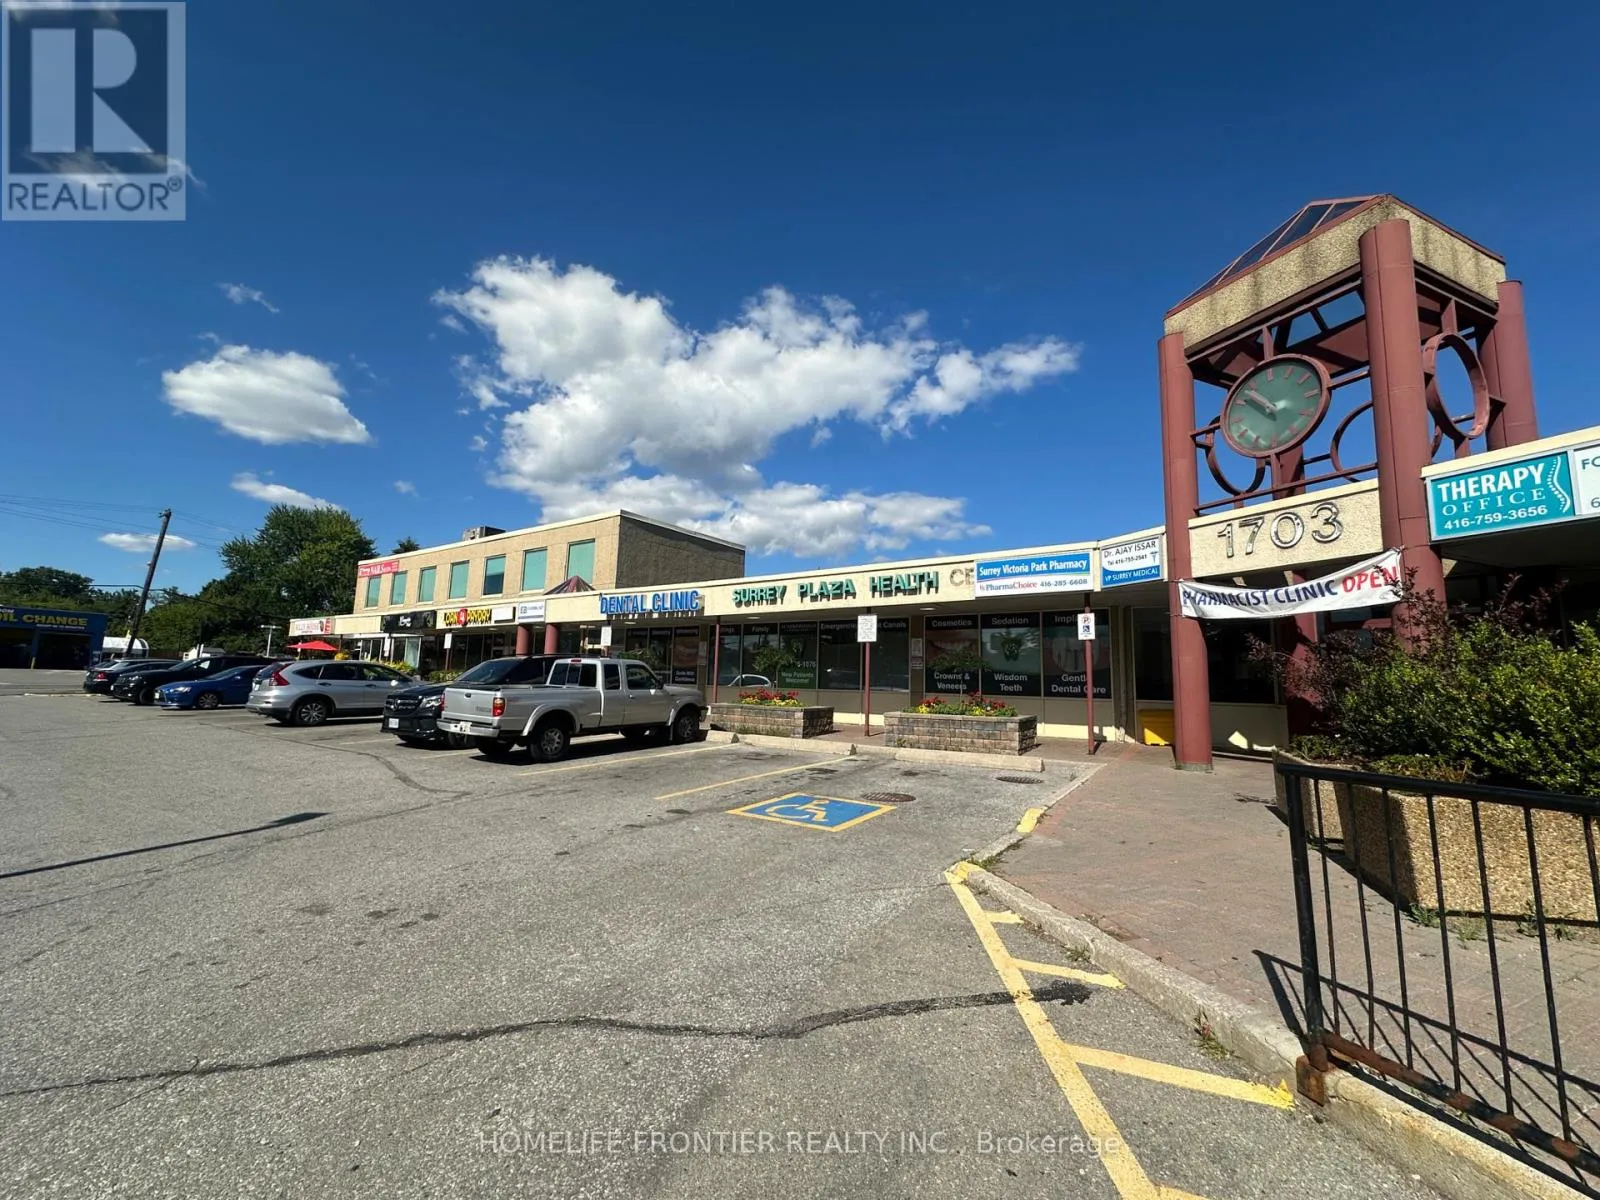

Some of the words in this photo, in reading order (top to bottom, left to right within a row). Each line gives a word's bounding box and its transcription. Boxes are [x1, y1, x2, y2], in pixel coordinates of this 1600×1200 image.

[1438, 463, 1545, 502] THERAPY
[1442, 488, 1546, 516] OFFICE
[1444, 505, 1548, 530] 416-759-3656
[1217, 501, 1343, 558] 1703
[1104, 550, 1114, 558] Dr.
[1115, 546, 1132, 555] AJAY
[1134, 541, 1156, 551] ISSAR
[979, 566, 1001, 577] Surrey
[1002, 563, 1029, 574] Victoria
[1031, 562, 1048, 571] Park
[1049, 560, 1087, 571] Pharmacy
[1112, 572, 1132, 580] SURREY
[1133, 567, 1158, 576] MEDICAL
[732, 586, 787, 603] SURREY
[797, 579, 856, 597] PLAZA
[869, 571, 939, 592] HEALTH
[986, 582, 1038, 591] PharmaChoice
[1182, 589, 1269, 606] PHARMACIST
[1273, 580, 1338, 604] CLINIC
[1342, 566, 1397, 592] OPEN
[600, 594, 647, 614] DENTAL
[652, 590, 700, 612] CLINIC
[22, 614, 88, 626] CHANGE
[932, 619, 973, 628] Cosmetics
[992, 617, 1029, 625] Sedation
[1055, 615, 1078, 624] Impl
[934, 673, 962, 681] Crowns
[994, 674, 1028, 682] Wisdom
[1061, 673, 1087, 682] Gentl
[1000, 684, 1023, 692] Teeth
[1051, 684, 1081, 693] Dental
